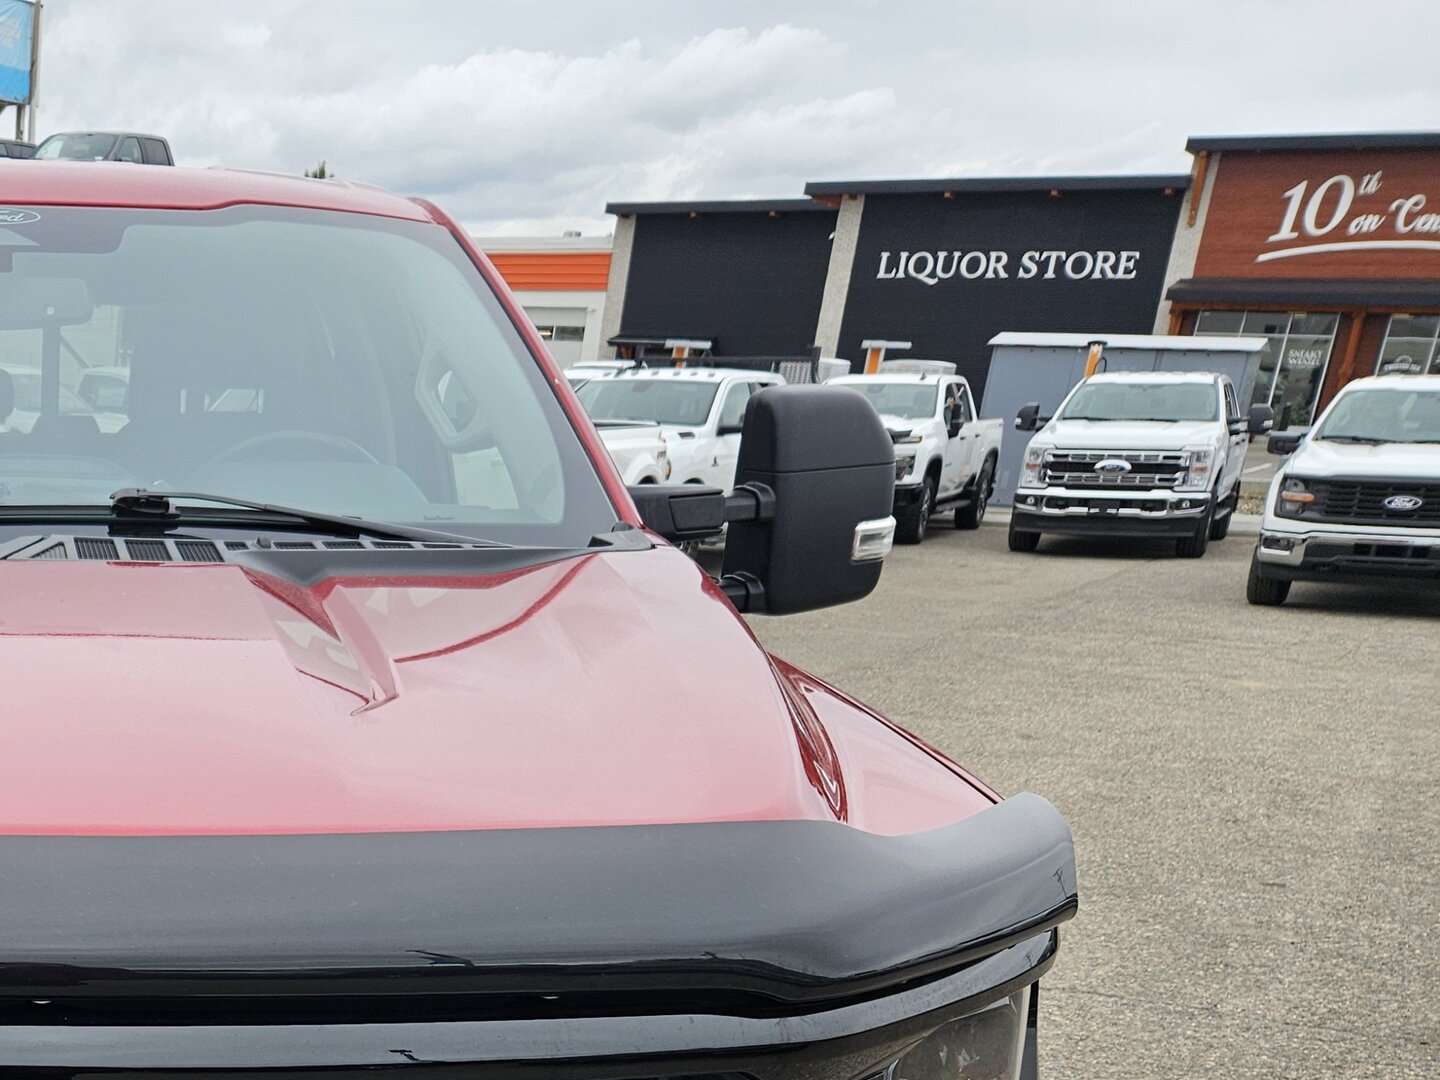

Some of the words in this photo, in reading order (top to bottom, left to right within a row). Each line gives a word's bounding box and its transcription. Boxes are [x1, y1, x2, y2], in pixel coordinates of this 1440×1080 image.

[1347, 213, 1386, 236] on
[876, 250, 1009, 286] LIQUOR
[1017, 250, 1140, 280] STORE
